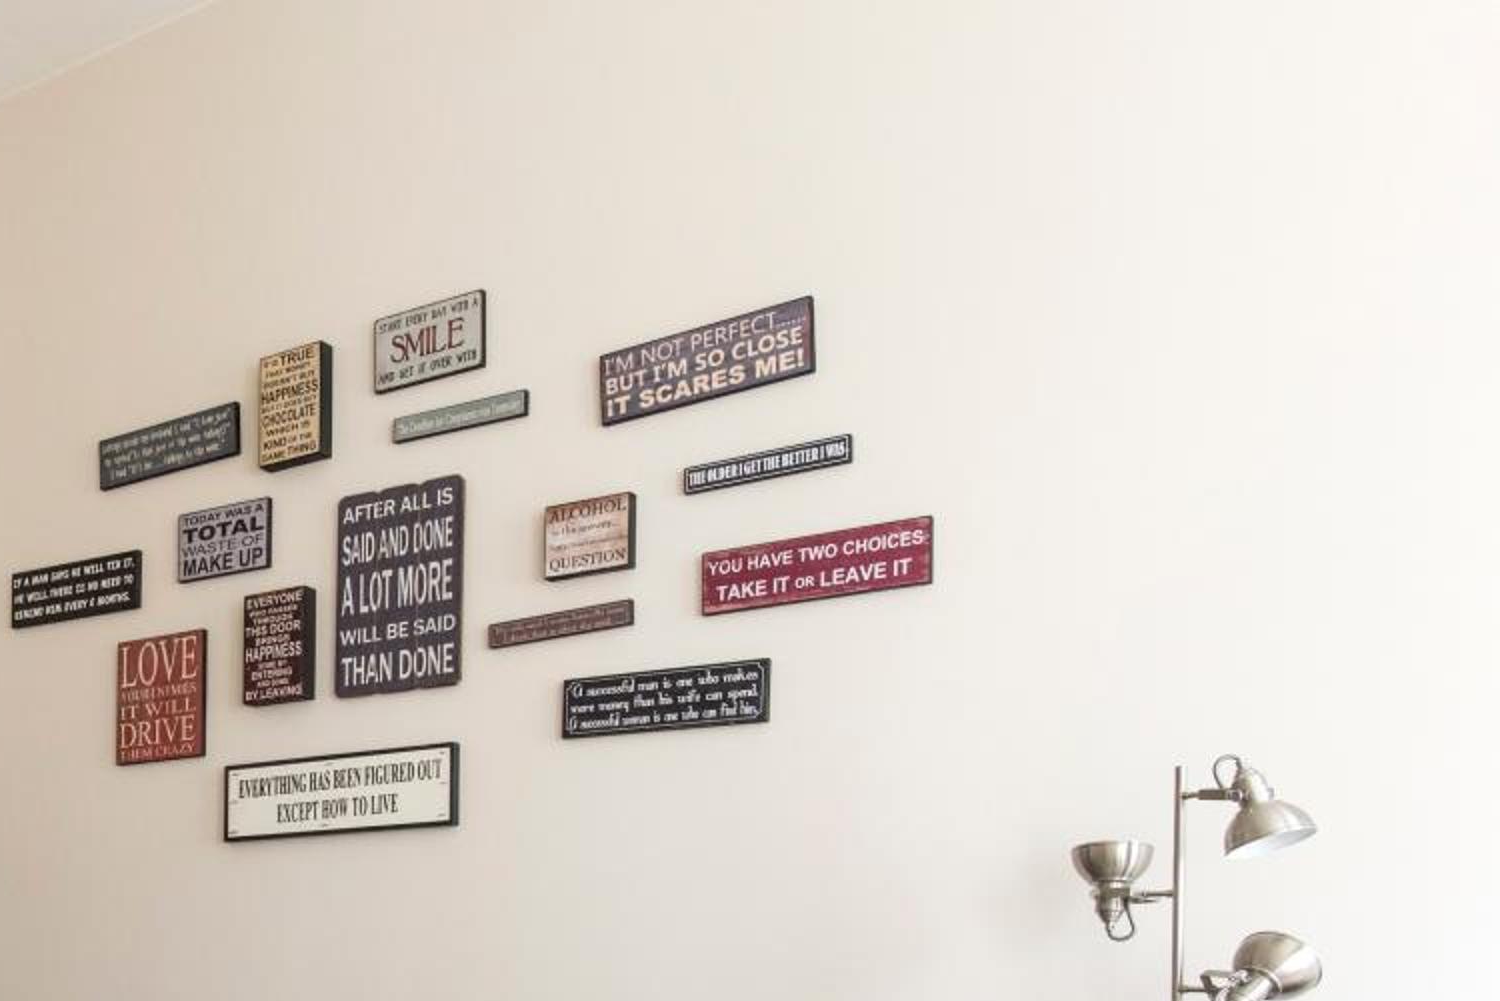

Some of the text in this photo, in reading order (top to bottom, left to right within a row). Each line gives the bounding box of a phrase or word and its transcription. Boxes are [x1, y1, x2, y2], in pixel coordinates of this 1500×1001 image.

[390, 317, 465, 363] SMILE
[280, 347, 315, 366] TRUE
[604, 352, 634, 376] I'M
[641, 338, 685, 365] NOT
[605, 325, 803, 395] BUT I'M SO CLOSE
[261, 379, 318, 404] HAPPINESS
[606, 348, 805, 417] IT SCARES ME!
[262, 403, 316, 429] CHOCOLATE
[263, 437, 286, 450] KIND
[287, 440, 316, 456] THING
[689, 472, 706, 486] THE
[707, 465, 739, 482] OLDER
[744, 460, 762, 475] GET
[763, 455, 780, 471] THE
[782, 447, 818, 467] BETTER
[826, 441, 845, 457] WAS
[184, 504, 263, 526] TODAY WAS A
[343, 487, 454, 525] AFTER ALL IS
[548, 498, 626, 524] ALCOHOL
[182, 516, 264, 544] TOTAL
[342, 515, 453, 567] SAID AND DONE
[181, 532, 264, 558] WASTE OF
[184, 547, 263, 576] MAKE UP
[550, 548, 626, 572] QUESTION
[707, 558, 743, 576] YOU
[747, 550, 793, 571] HAVE
[798, 543, 838, 562] TWO
[341, 557, 453, 617] A LOT MORE
[716, 558, 913, 601] TAKE IT OR LEAVE IT
[246, 590, 304, 610] EVERYONE
[245, 619, 301, 638] THIS DOOR
[340, 614, 456, 647] WILL BE SAID
[121, 635, 198, 689] LOVE
[245, 641, 302, 664] HAPPINESS
[341, 643, 455, 687] THAN DONE
[260, 682, 303, 700] LEAVING
[638, 682, 658, 691] man
[663, 677, 673, 689] is
[676, 679, 693, 687] one
[706, 692, 723, 700] can
[121, 697, 197, 720] IT WILL
[121, 714, 195, 749] DRIVE
[121, 741, 195, 761] THEM CRAZY
[239, 759, 442, 799] EVERYTHING HAS BEEN FIGURED OUT
[276, 793, 399, 823] EXCEPT HOW TO LIVE
